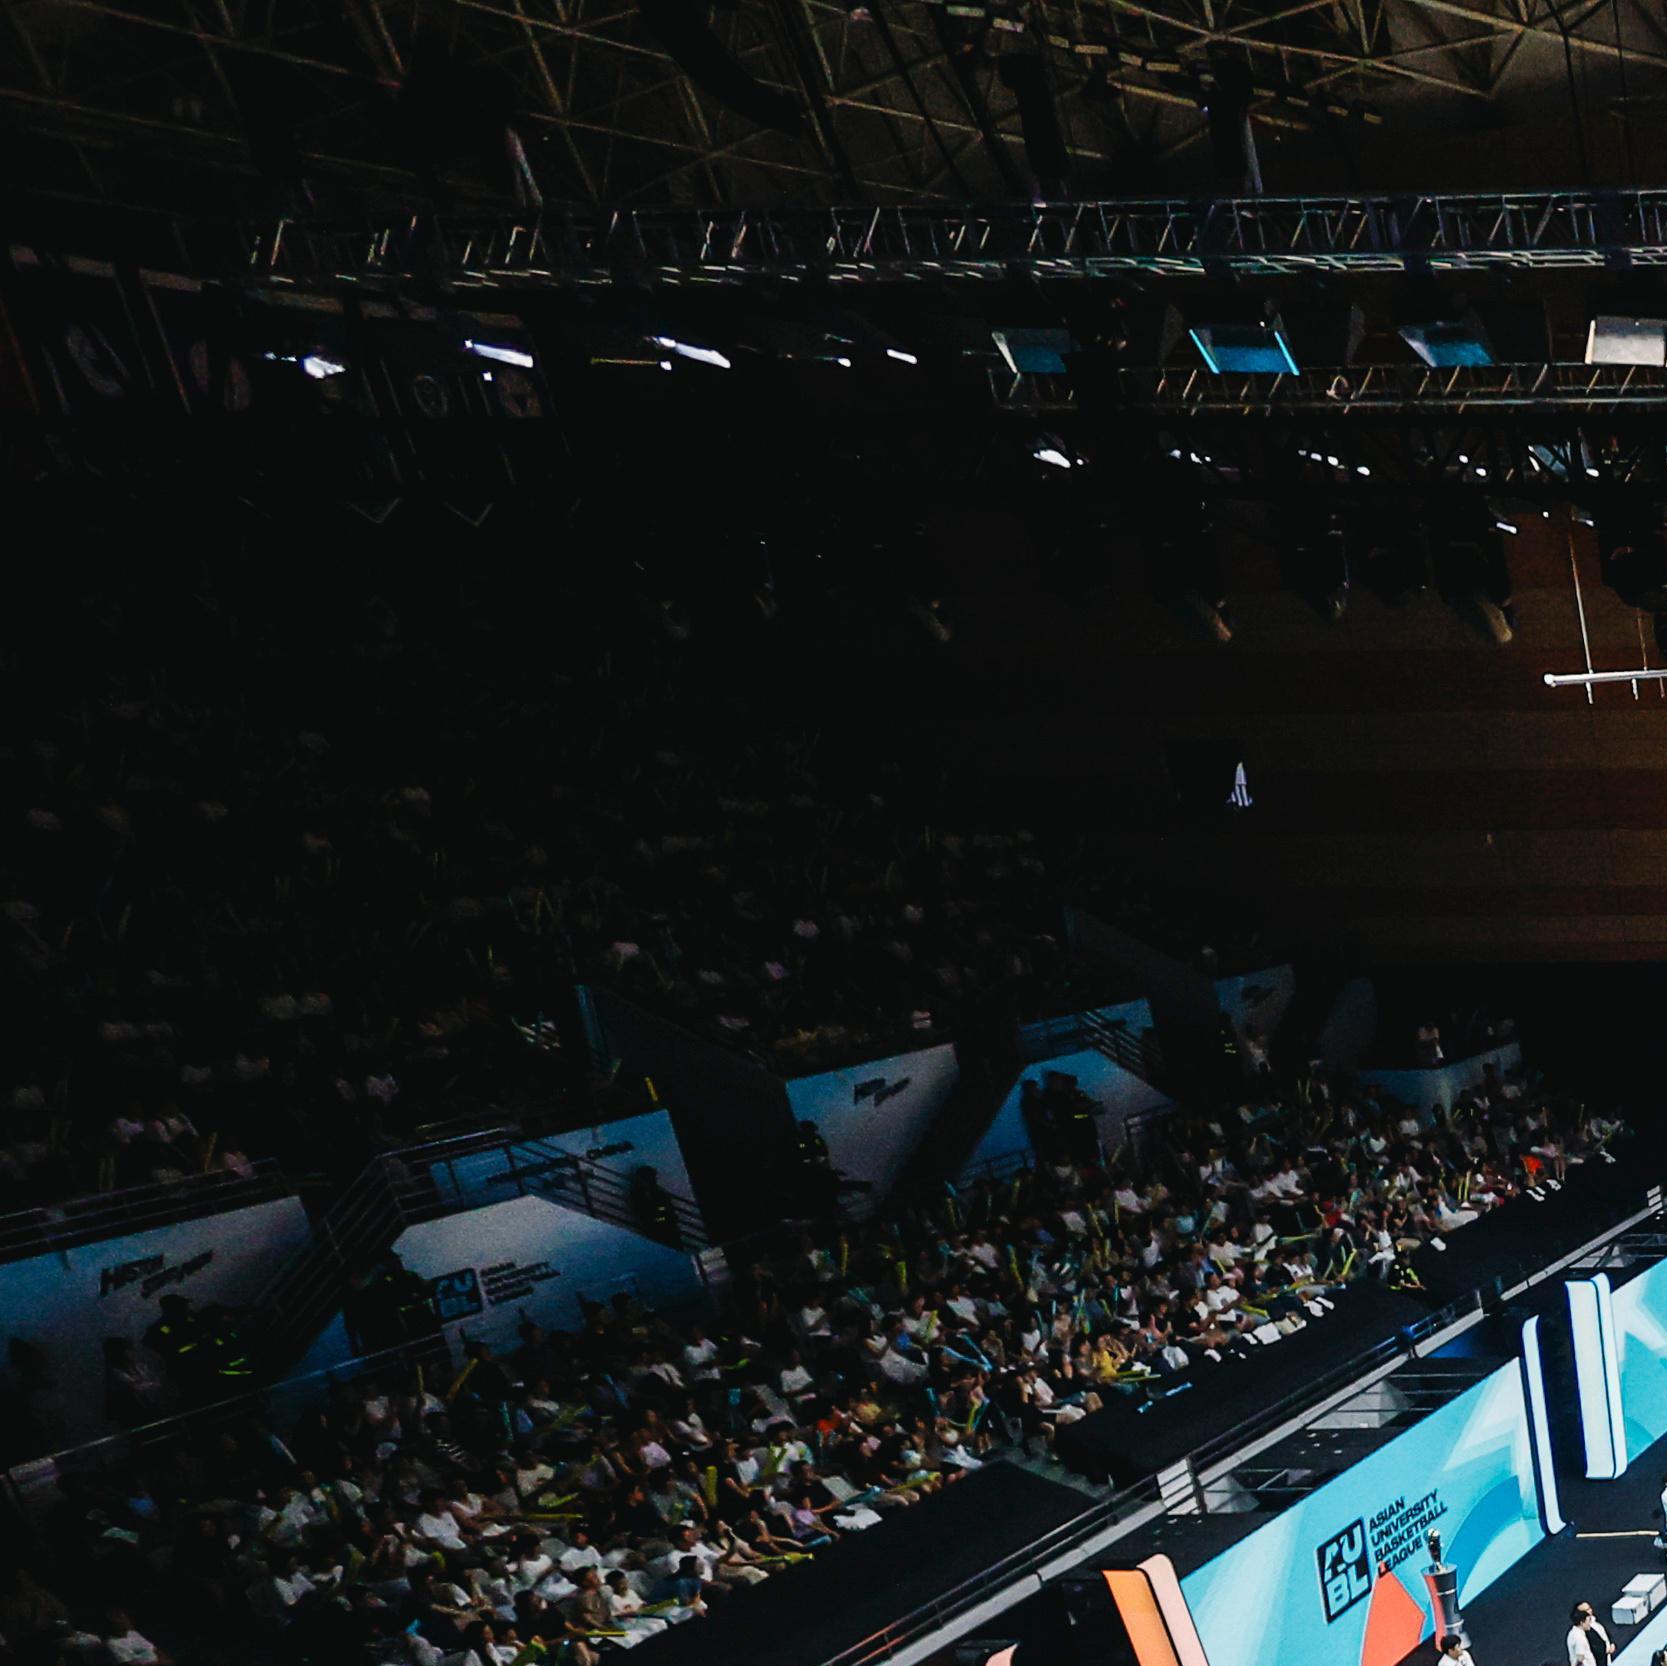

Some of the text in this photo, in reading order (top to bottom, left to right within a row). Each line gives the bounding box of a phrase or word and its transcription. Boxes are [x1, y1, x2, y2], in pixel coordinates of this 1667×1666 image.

[1369, 1496, 1405, 1533] ASIAN
[1371, 1488, 1438, 1548] UNIVERSITY
[1374, 1501, 1448, 1564] BASKETBALL
[1378, 1537, 1423, 1578] LEAGUE
[1326, 1563, 1370, 1617] BL
